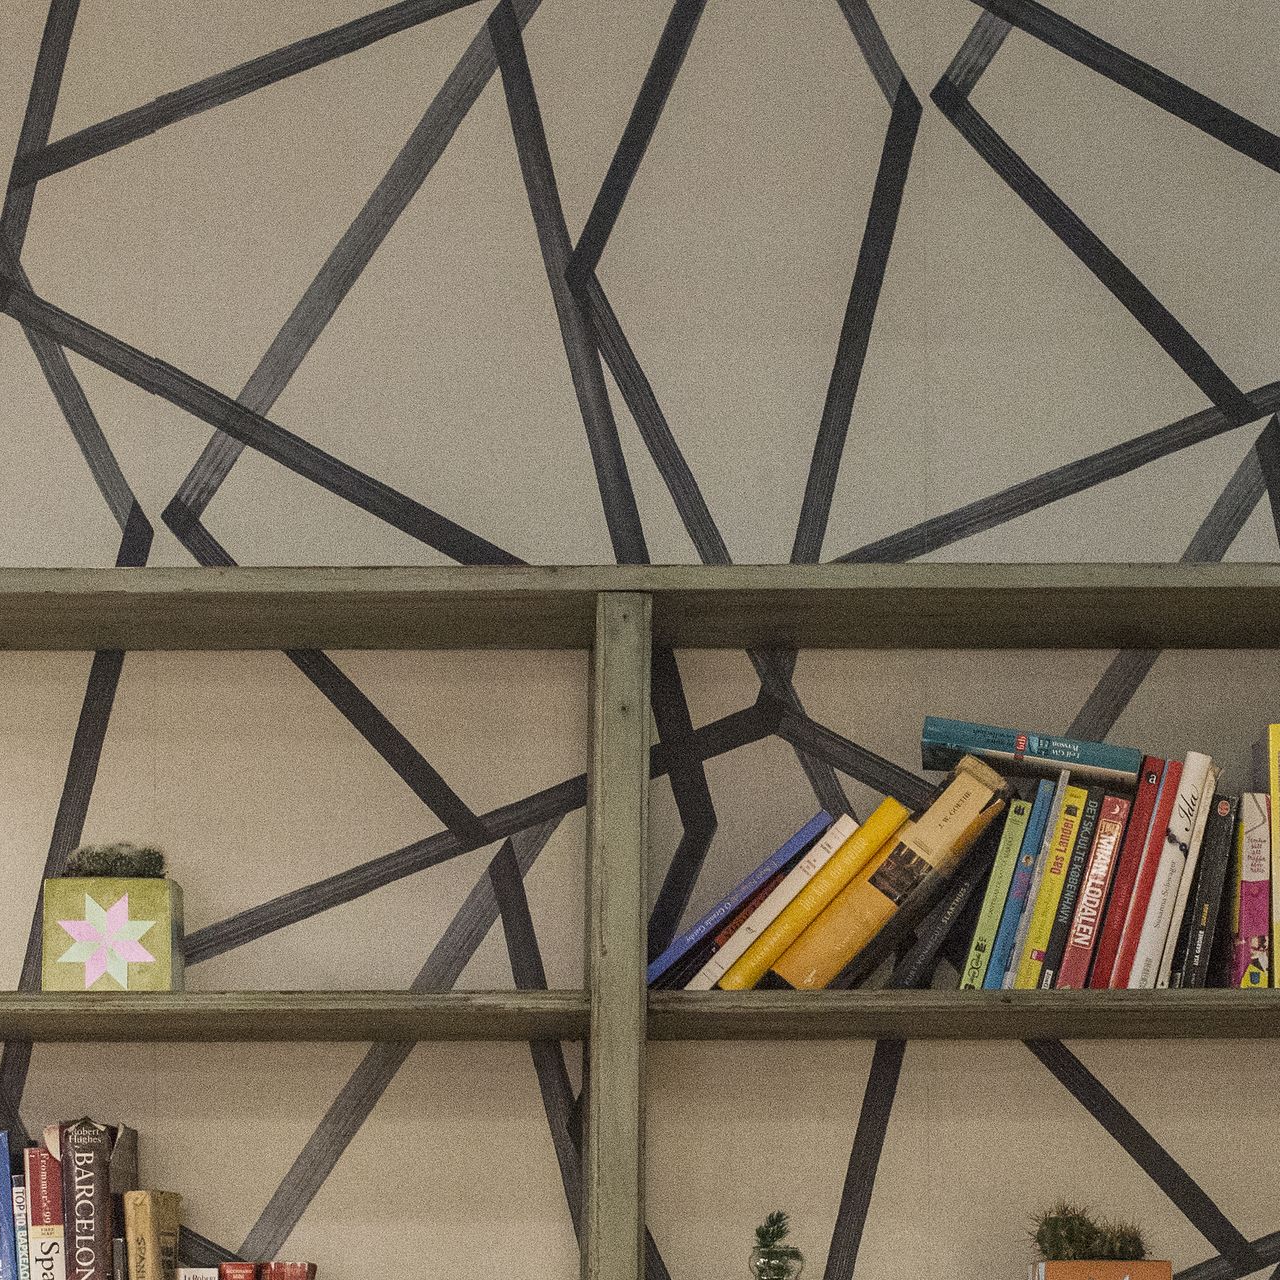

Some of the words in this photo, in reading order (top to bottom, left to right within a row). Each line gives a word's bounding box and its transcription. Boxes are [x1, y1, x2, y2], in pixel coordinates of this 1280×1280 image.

[1084, 799, 1099, 821] DET
[1172, 789, 1201, 829] Ida
[1072, 820, 1094, 864] SKJULTE
[1049, 853, 1065, 876] Das
[1055, 863, 1082, 925] KØBENHAVN
[702, 905, 726, 927] Grande
[683, 922, 707, 944] Gatsby
[70, 1135, 102, 1145] Hughes
[37, 1151, 52, 1208] Frommer's
[14, 1189, 25, 1211] TOP
[14, 1213, 25, 1227] 10
